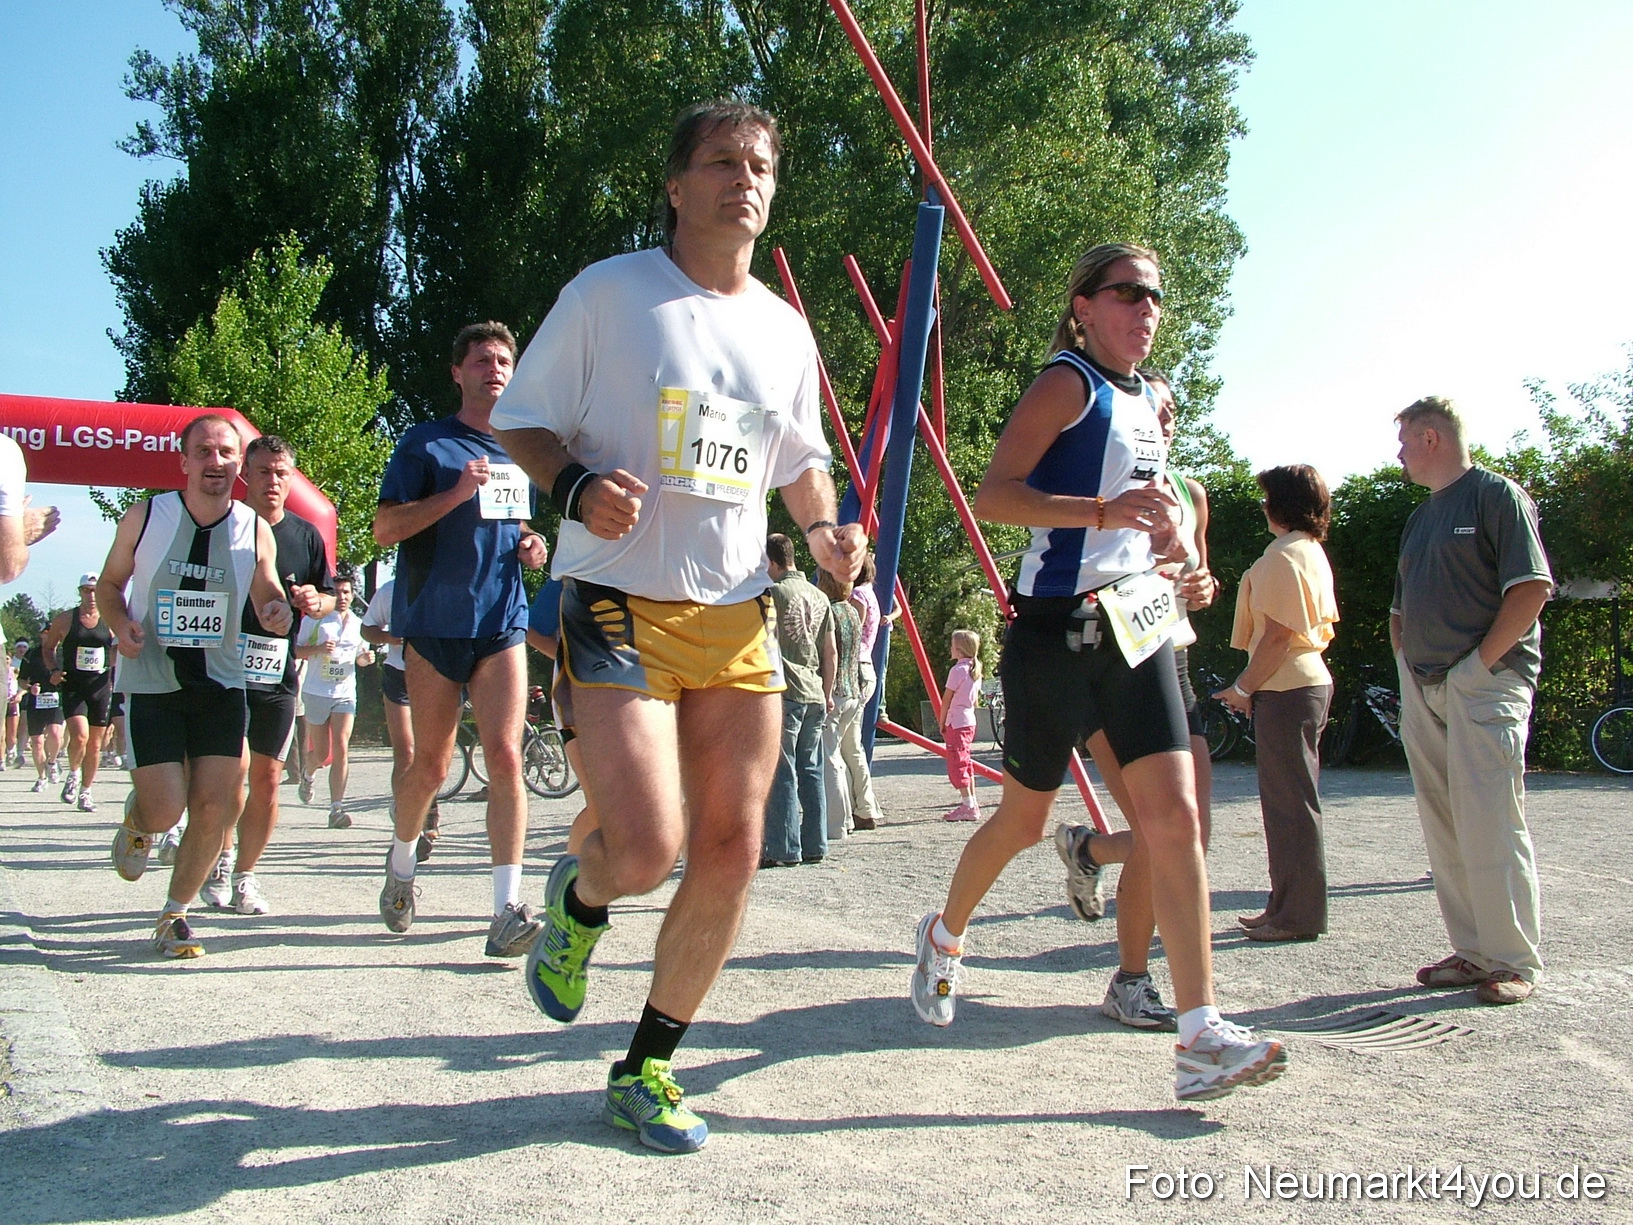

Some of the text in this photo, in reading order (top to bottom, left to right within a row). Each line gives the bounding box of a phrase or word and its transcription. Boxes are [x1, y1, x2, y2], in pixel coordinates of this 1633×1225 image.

[698, 403, 727, 422] Mario
[2, 425, 183, 453] ng LGS-Park
[691, 437, 749, 474] 1076
[490, 470, 511, 481] Hans
[168, 560, 226, 584] THULE
[175, 595, 217, 609] Günther
[160, 610, 170, 621] C
[1131, 592, 1170, 632] 1059
[176, 614, 222, 633] 3448
[247, 639, 278, 653] Thomas
[84, 656, 99, 665] 906
[244, 654, 281, 673] 3374
[329, 667, 345, 676] 898
